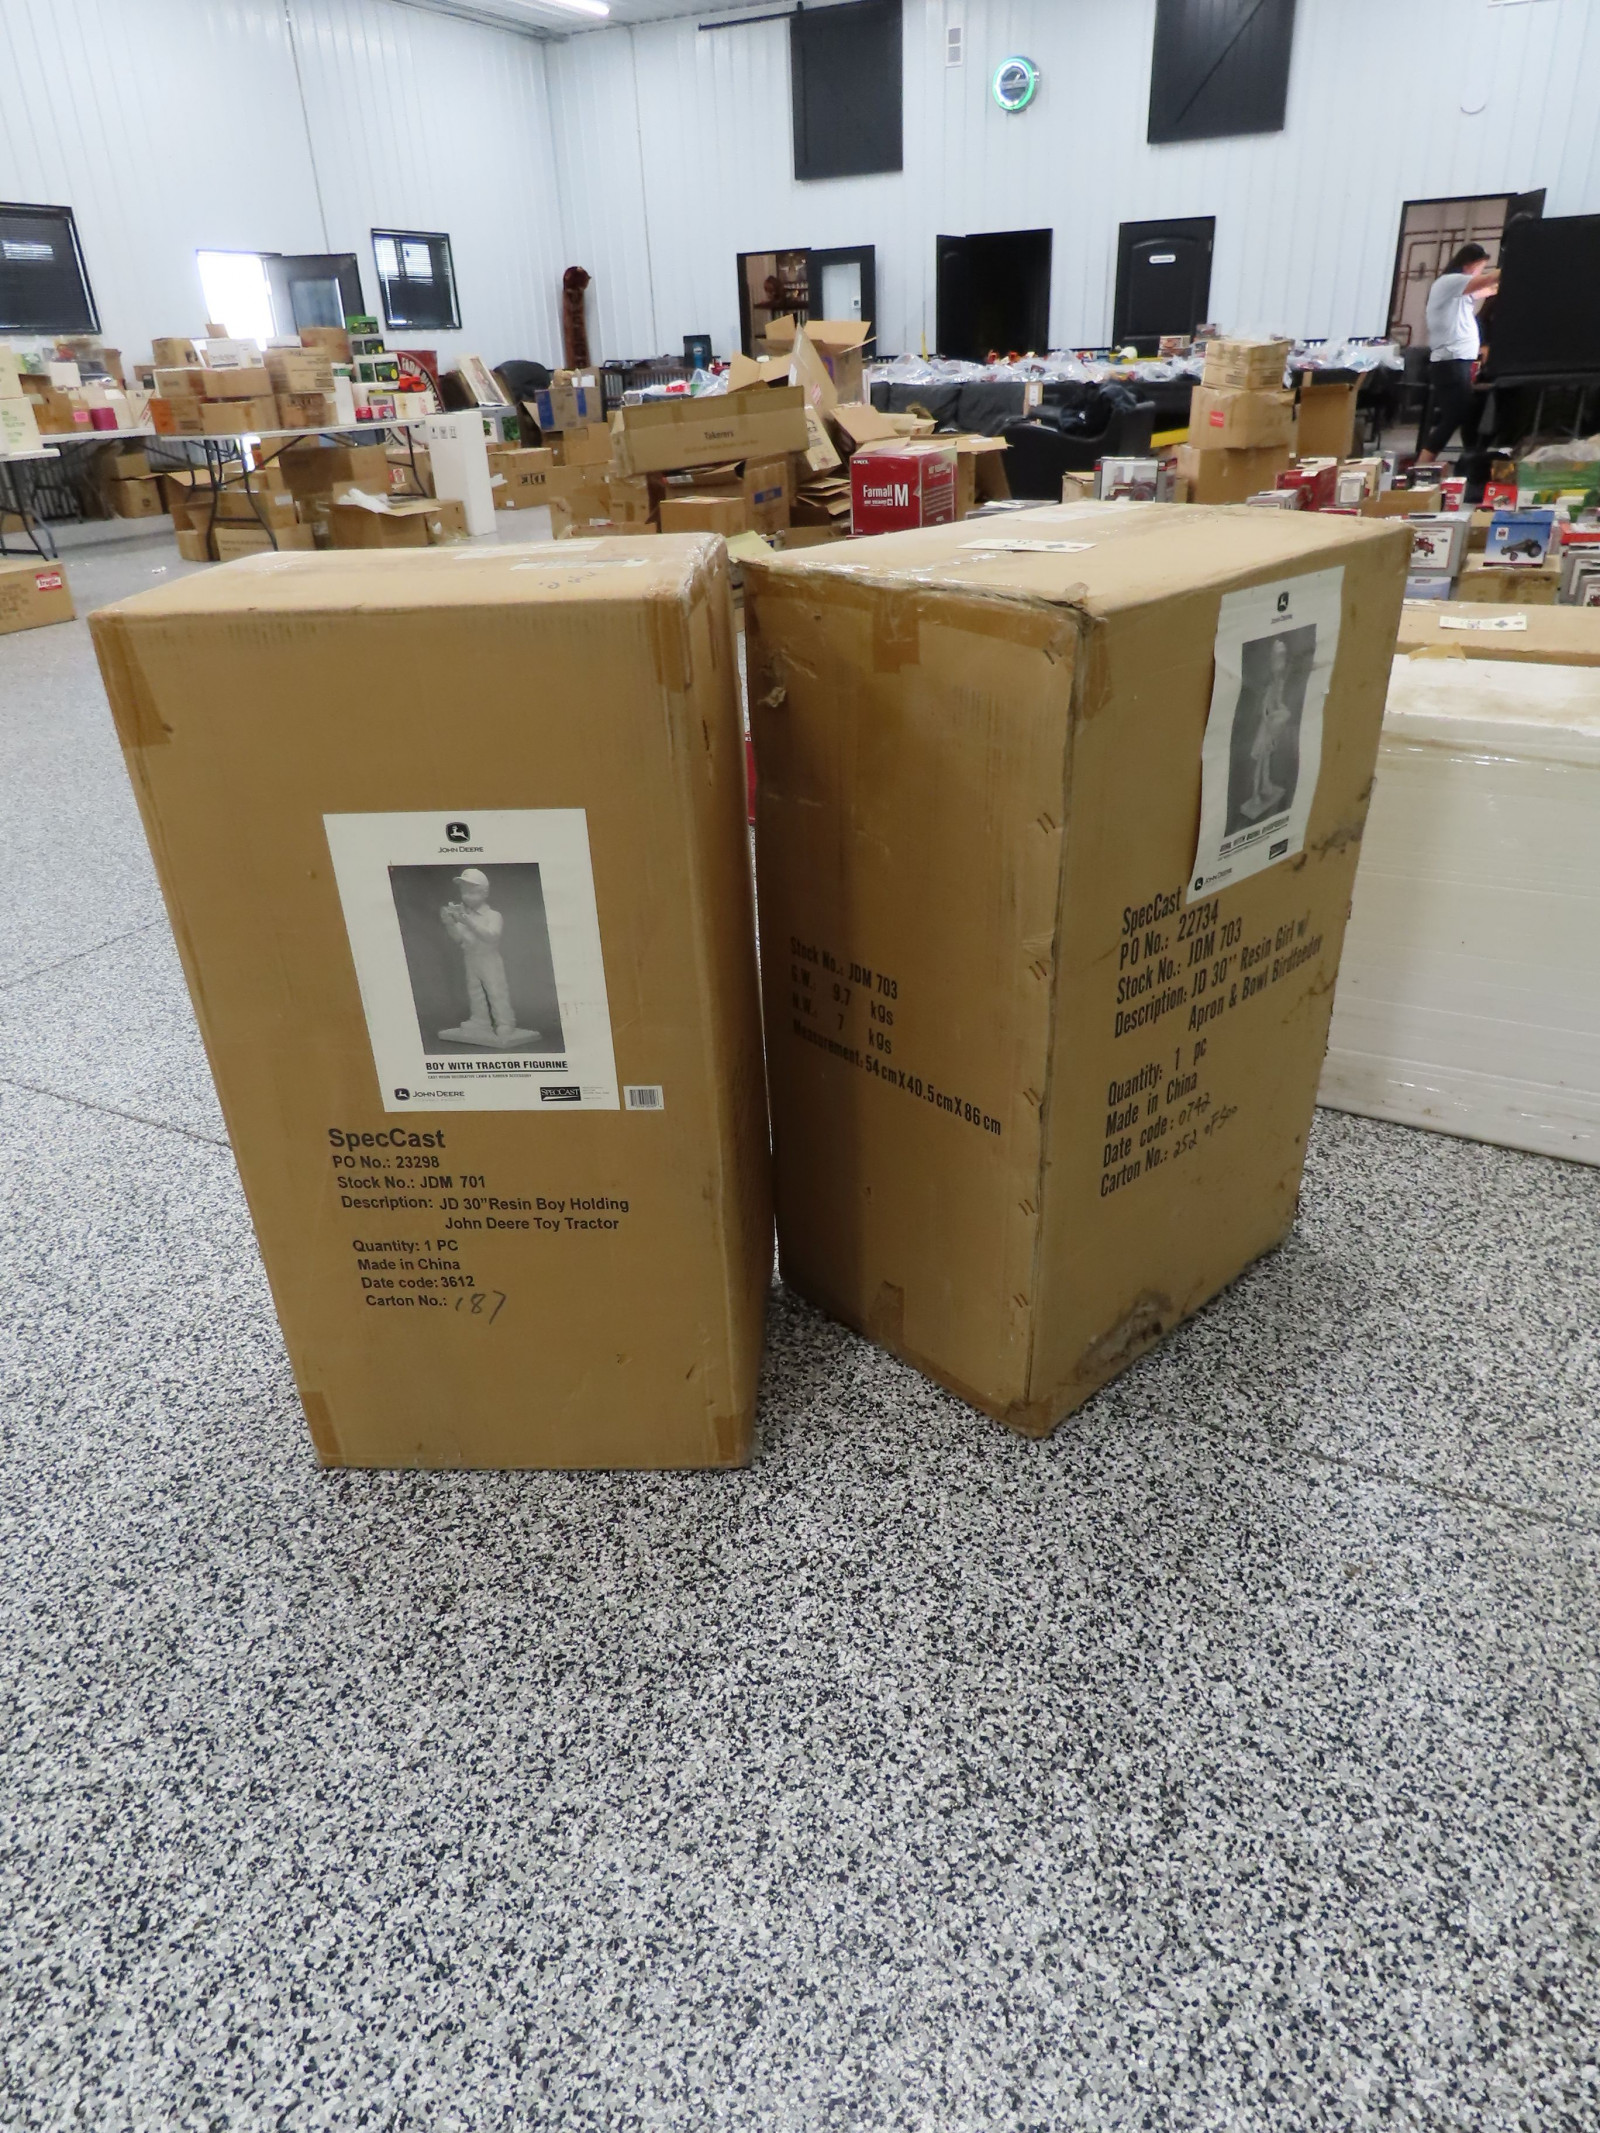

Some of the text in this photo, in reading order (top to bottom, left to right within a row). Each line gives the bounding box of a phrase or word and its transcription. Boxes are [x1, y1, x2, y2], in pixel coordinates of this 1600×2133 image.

[863, 484, 893, 498] Farmall
[894, 483, 909, 507] M
[1122, 886, 1182, 938] SpecCast
[1119, 898, 1219, 971] PO No.: 22734
[790, 936, 819, 965] Stock
[848, 962, 872, 989] JDM
[875, 972, 898, 1000] 703
[1116, 917, 1242, 1005] Stock No.: JDM 703
[1114, 986, 1187, 1039] Description:
[1191, 968, 1207, 999] JD
[1240, 936, 1272, 972] Resin
[1275, 919, 1295, 952] Girl
[832, 982, 852, 1007] 9.7
[870, 1000, 894, 1026] kgs
[1188, 996, 1225, 1032] Apron
[1228, 983, 1237, 1008] &
[1242, 964, 1269, 1001] Bowl
[837, 1012, 844, 1031] 7
[868, 1028, 892, 1055] kgs
[425, 1060, 568, 1071] BOY WITH TRACTOR FIGURINE
[1108, 1038, 1207, 1107] Quantity: 1 pc
[412, 1090, 436, 1098] JOHN
[1105, 1072, 1198, 1138] Made in China
[328, 1128, 446, 1151] SpecCast
[1103, 1137, 1132, 1168] Date
[332, 1155, 440, 1169] PO No.: 23298
[1100, 1147, 1169, 1198] Carton No.:
[337, 1175, 486, 1189] Stock No.: JDM 701
[341, 1195, 433, 1210] Description:
[439, 1197, 459, 1210] JD
[536, 1197, 566, 1213] Boy
[570, 1197, 630, 1213] Holding
[445, 1217, 619, 1232] John Deere Toy Tractor
[352, 1239, 459, 1254] Quantity: 1 PC
[357, 1257, 461, 1270] Made in China
[360, 1275, 476, 1289] Date code: 3612
[365, 1294, 448, 1307] Carton No.:
[455, 1289, 507, 1325] 187
